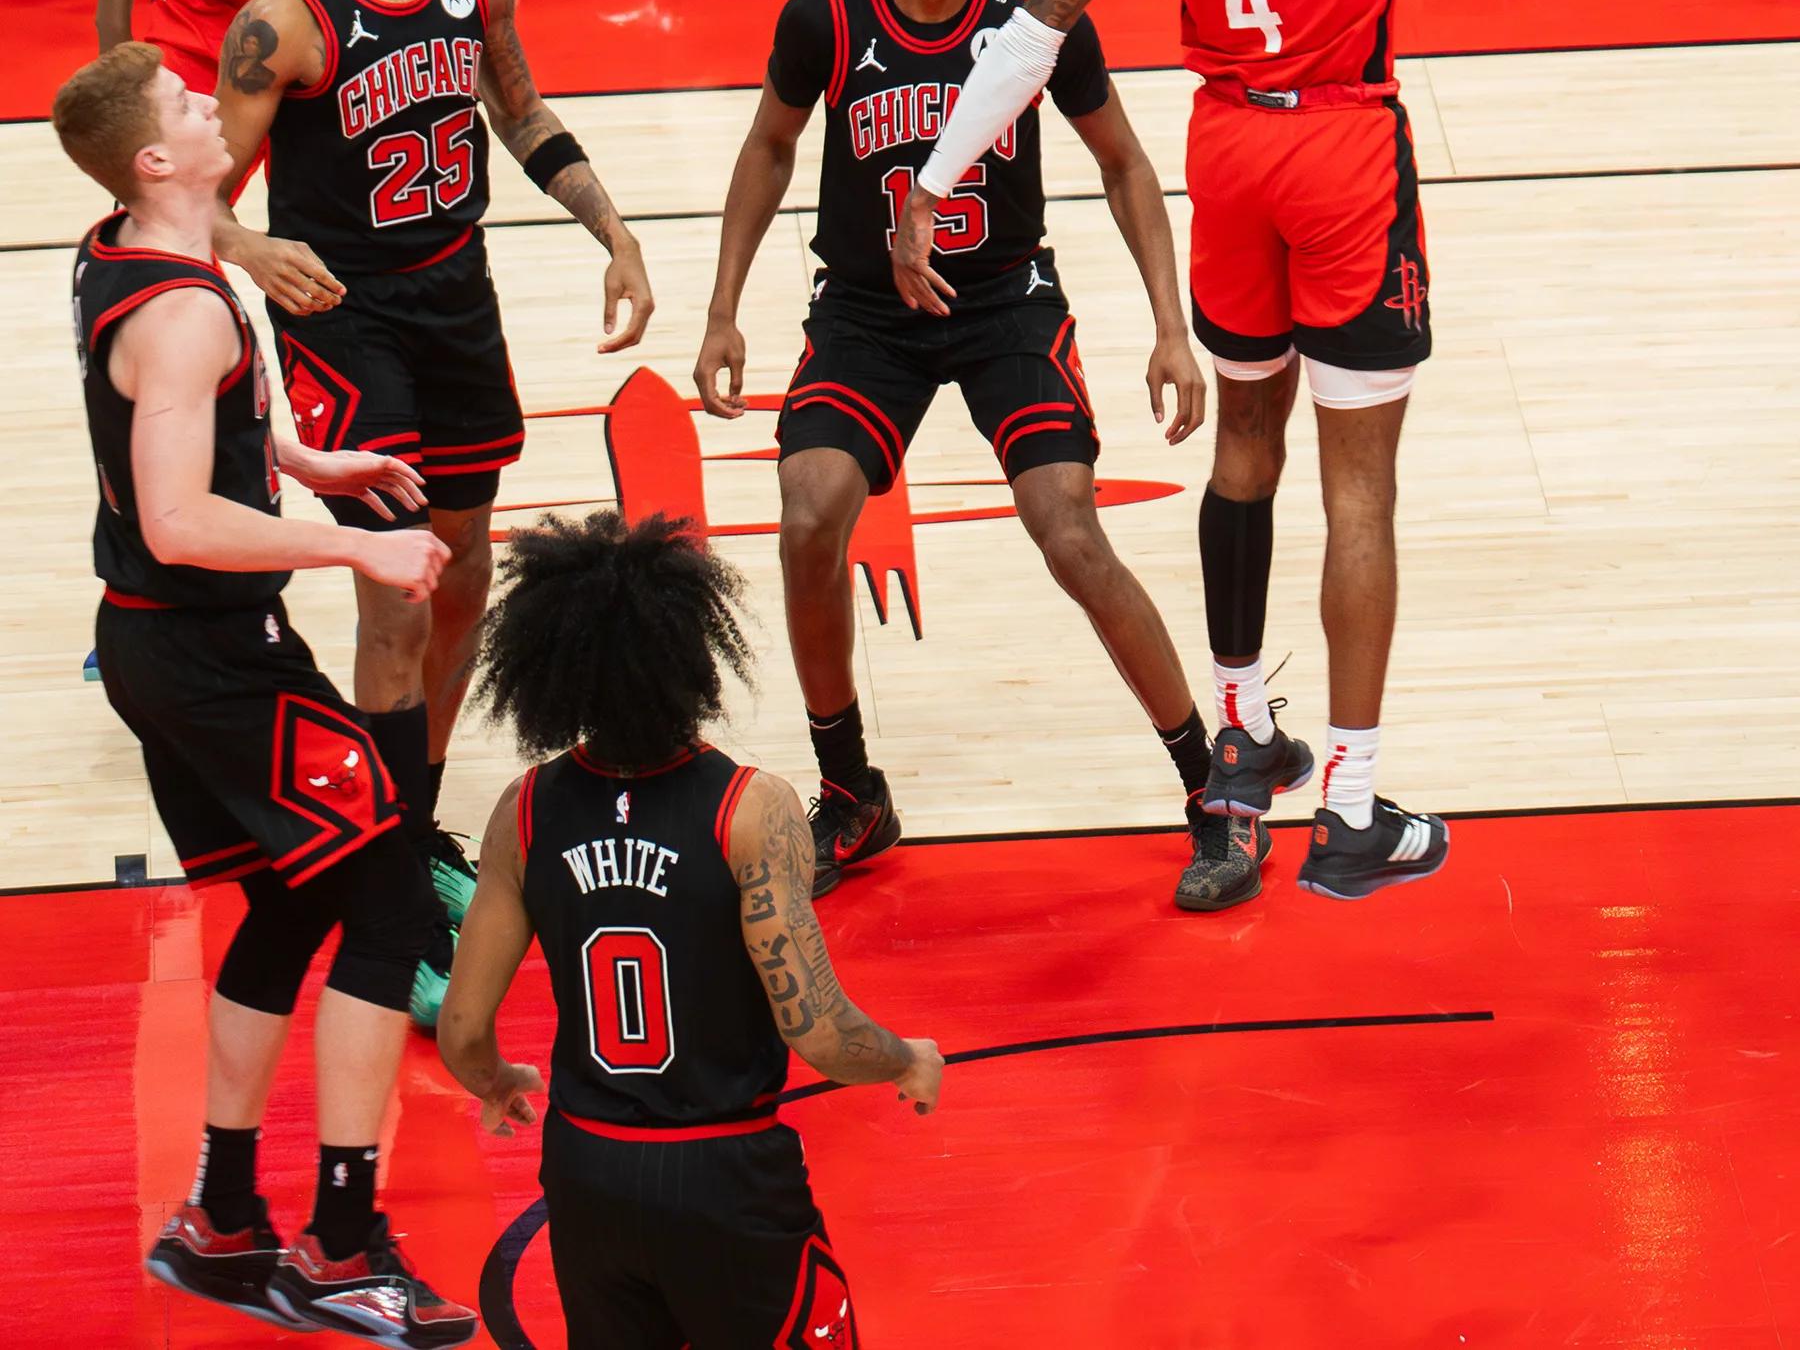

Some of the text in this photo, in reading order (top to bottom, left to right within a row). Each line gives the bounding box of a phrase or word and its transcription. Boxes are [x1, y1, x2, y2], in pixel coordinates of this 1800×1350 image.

[367, 107, 476, 228] 25
[882, 162, 989, 255] 15
[562, 838, 679, 898] WHITE
[581, 926, 675, 1075] 0
